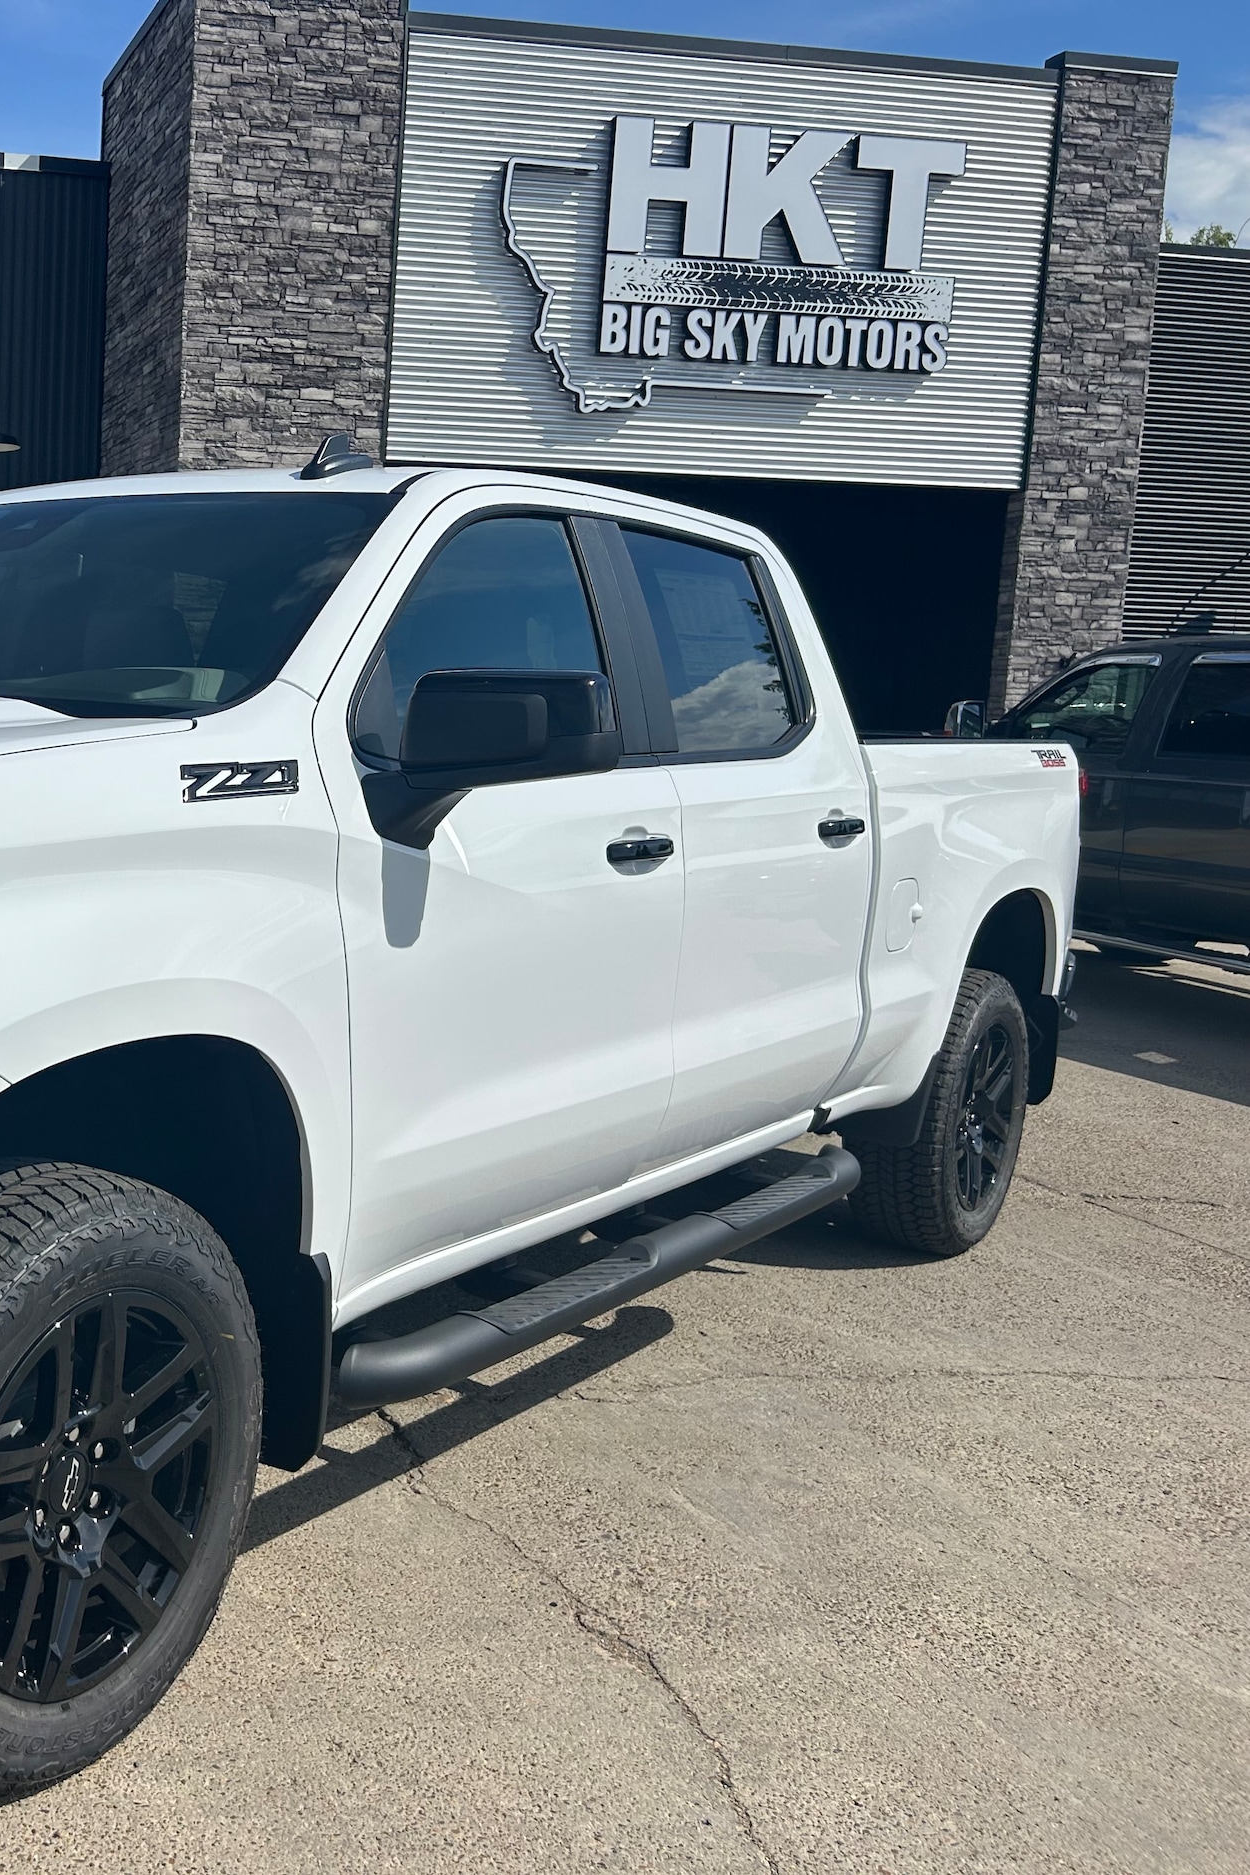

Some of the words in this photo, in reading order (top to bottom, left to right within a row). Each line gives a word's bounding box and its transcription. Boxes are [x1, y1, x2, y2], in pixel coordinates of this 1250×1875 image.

[607, 114, 968, 271] HKT
[599, 302, 671, 357] BIG
[685, 310, 767, 363] SKY
[776, 313, 949, 373] MOTORS
[180, 759, 300, 803] Z71
[1030, 749, 1067, 760] TRAIL
